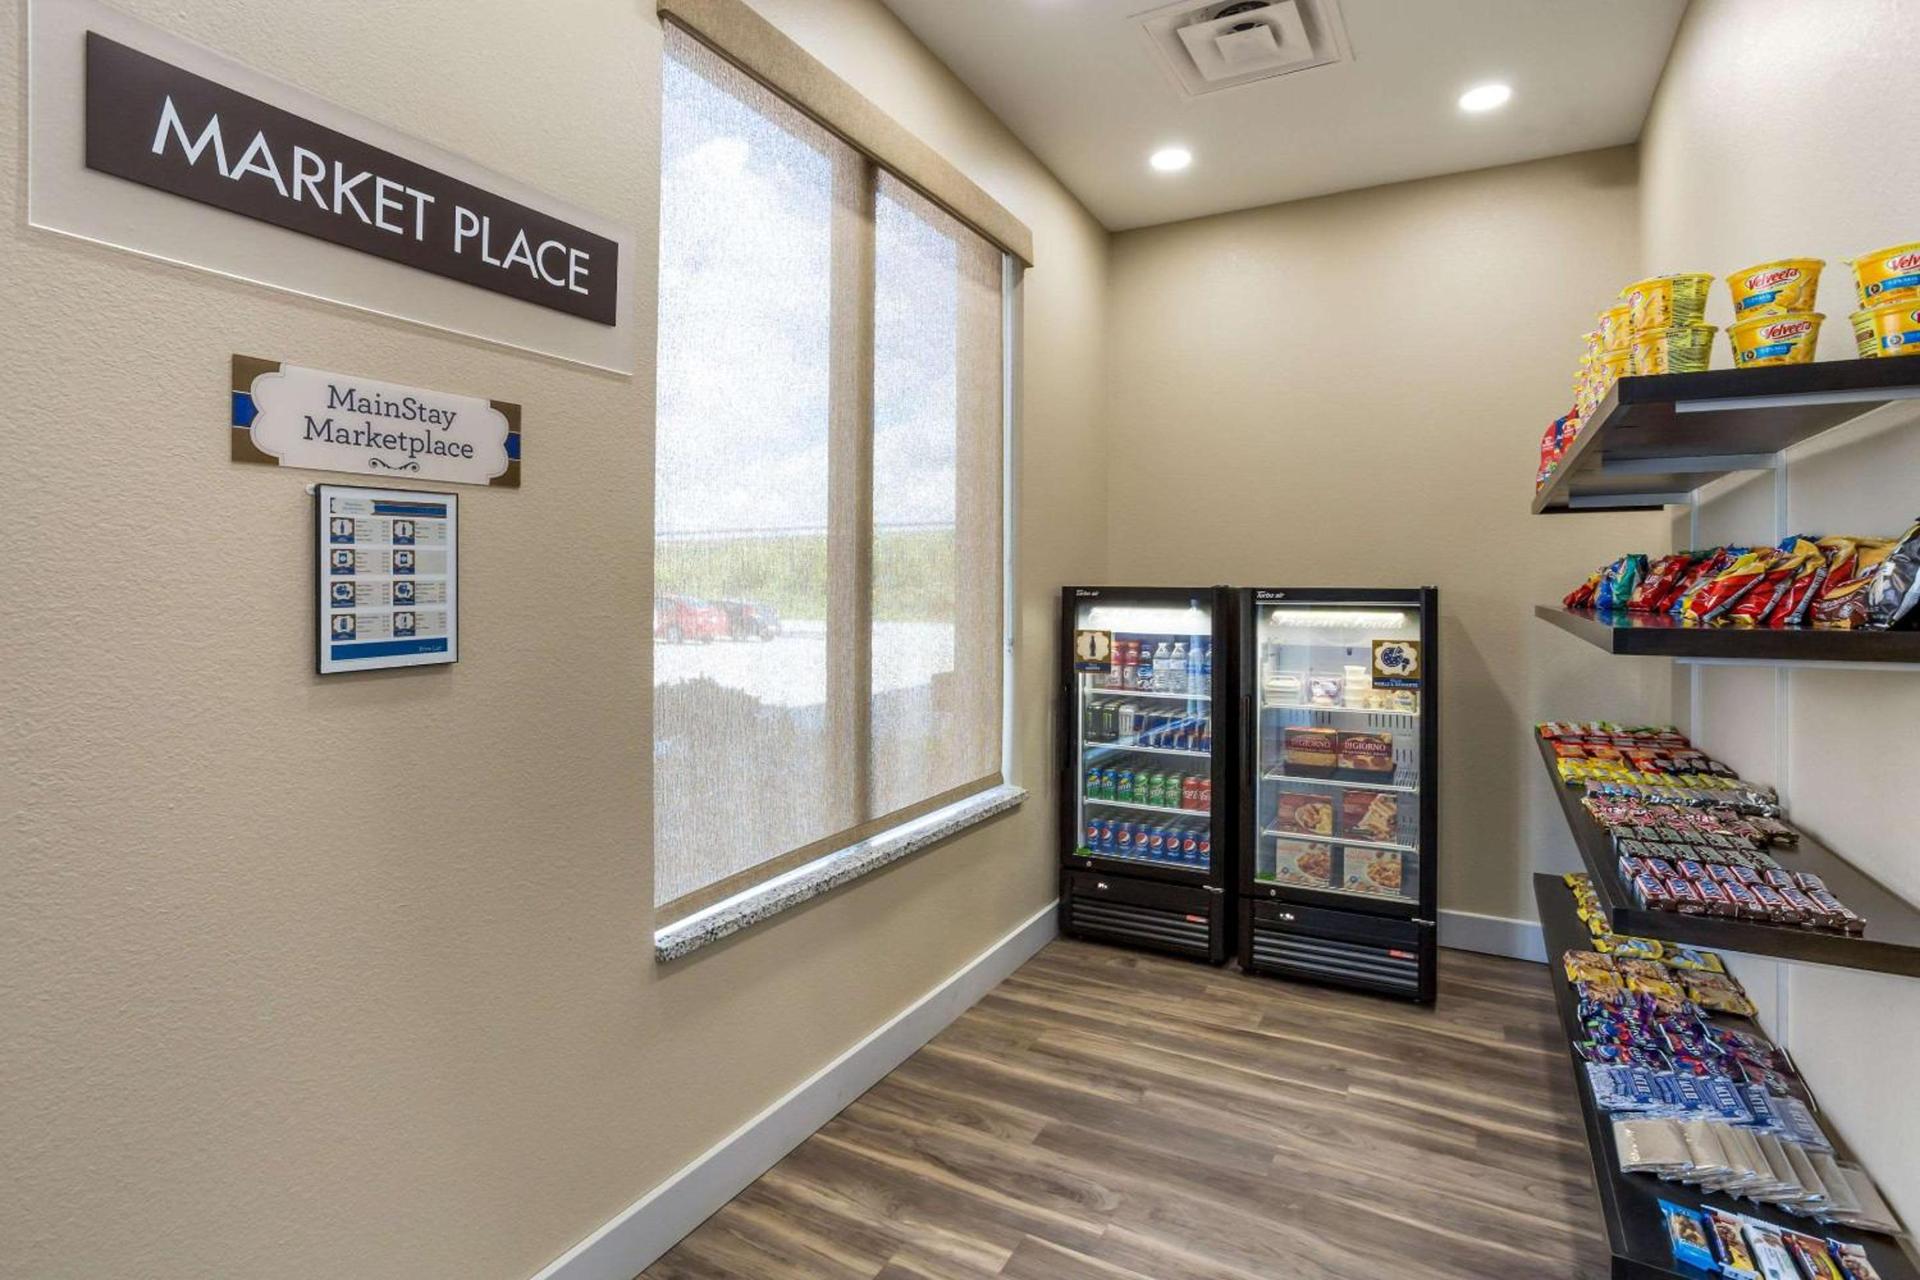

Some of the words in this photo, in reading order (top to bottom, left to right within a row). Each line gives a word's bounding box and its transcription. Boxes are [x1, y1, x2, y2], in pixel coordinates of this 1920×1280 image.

[151, 95, 435, 241] MARKET
[454, 205, 590, 296] PLACE
[1749, 267, 1799, 290] Velveeta
[1765, 320, 1812, 338] Velveeta
[327, 384, 456, 431] MainStay
[303, 415, 474, 458] Marketplace
[1256, 590, 1274, 599] Turbo
